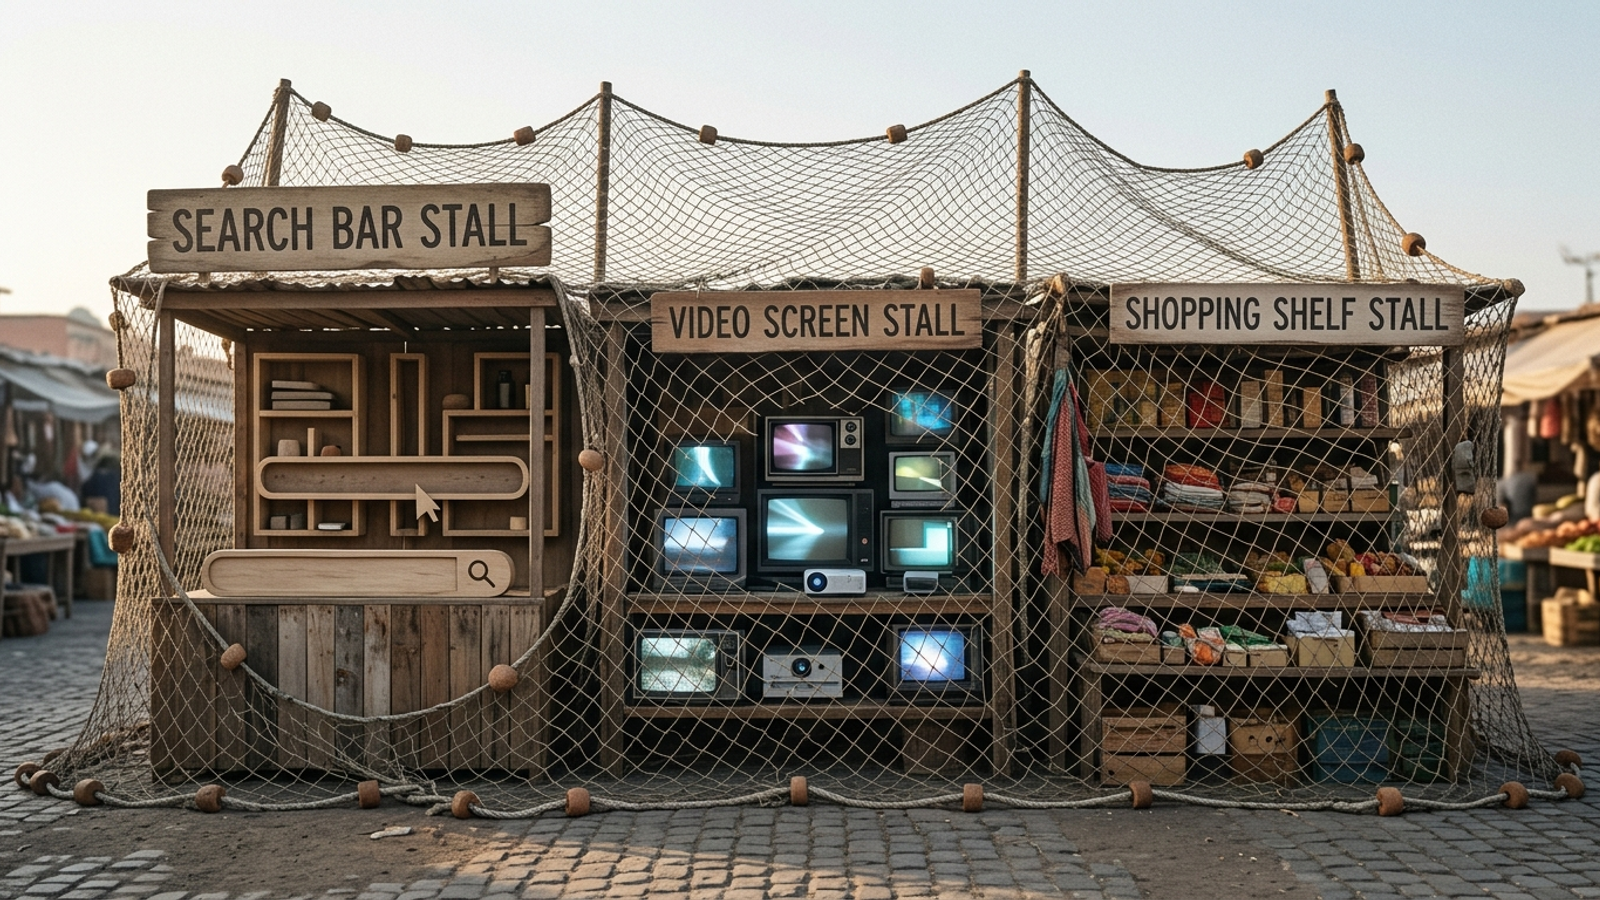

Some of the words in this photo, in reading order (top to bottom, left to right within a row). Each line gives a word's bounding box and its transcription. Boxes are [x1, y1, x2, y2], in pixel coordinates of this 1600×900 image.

[172, 206, 313, 253] SEARCH
[332, 204, 403, 250] BAR
[420, 202, 529, 248] STALL
[668, 305, 751, 339] VIDEO
[763, 303, 869, 338] SCREEN
[883, 303, 966, 337] STALL
[1125, 296, 1261, 331] SHOPPING
[1272, 296, 1357, 331] SHELF
[1368, 297, 1449, 331] STALL
